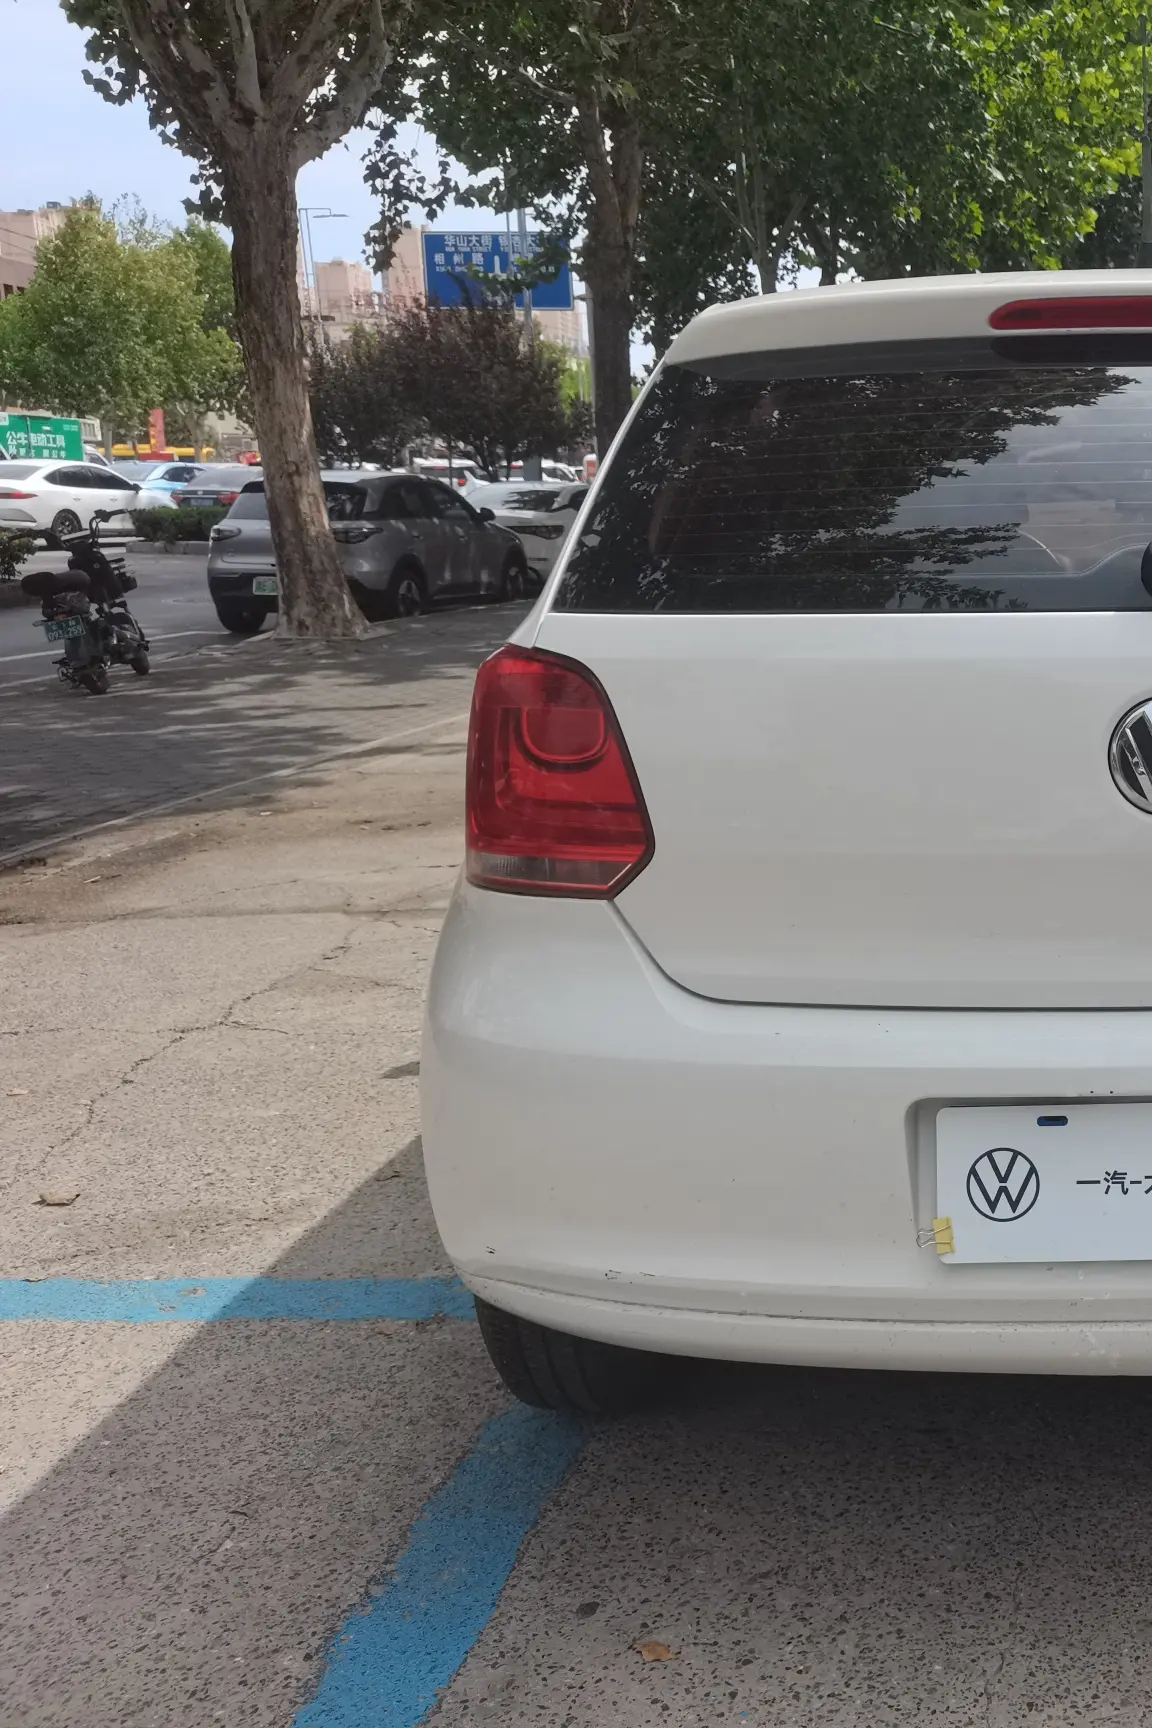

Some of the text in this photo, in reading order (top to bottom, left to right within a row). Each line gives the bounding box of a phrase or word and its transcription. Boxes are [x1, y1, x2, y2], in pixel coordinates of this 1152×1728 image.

[444, 235, 492, 247] 华山大街
[434, 253, 484, 265] 相州路
[6, 431, 66, 448] 公牛电动工具
